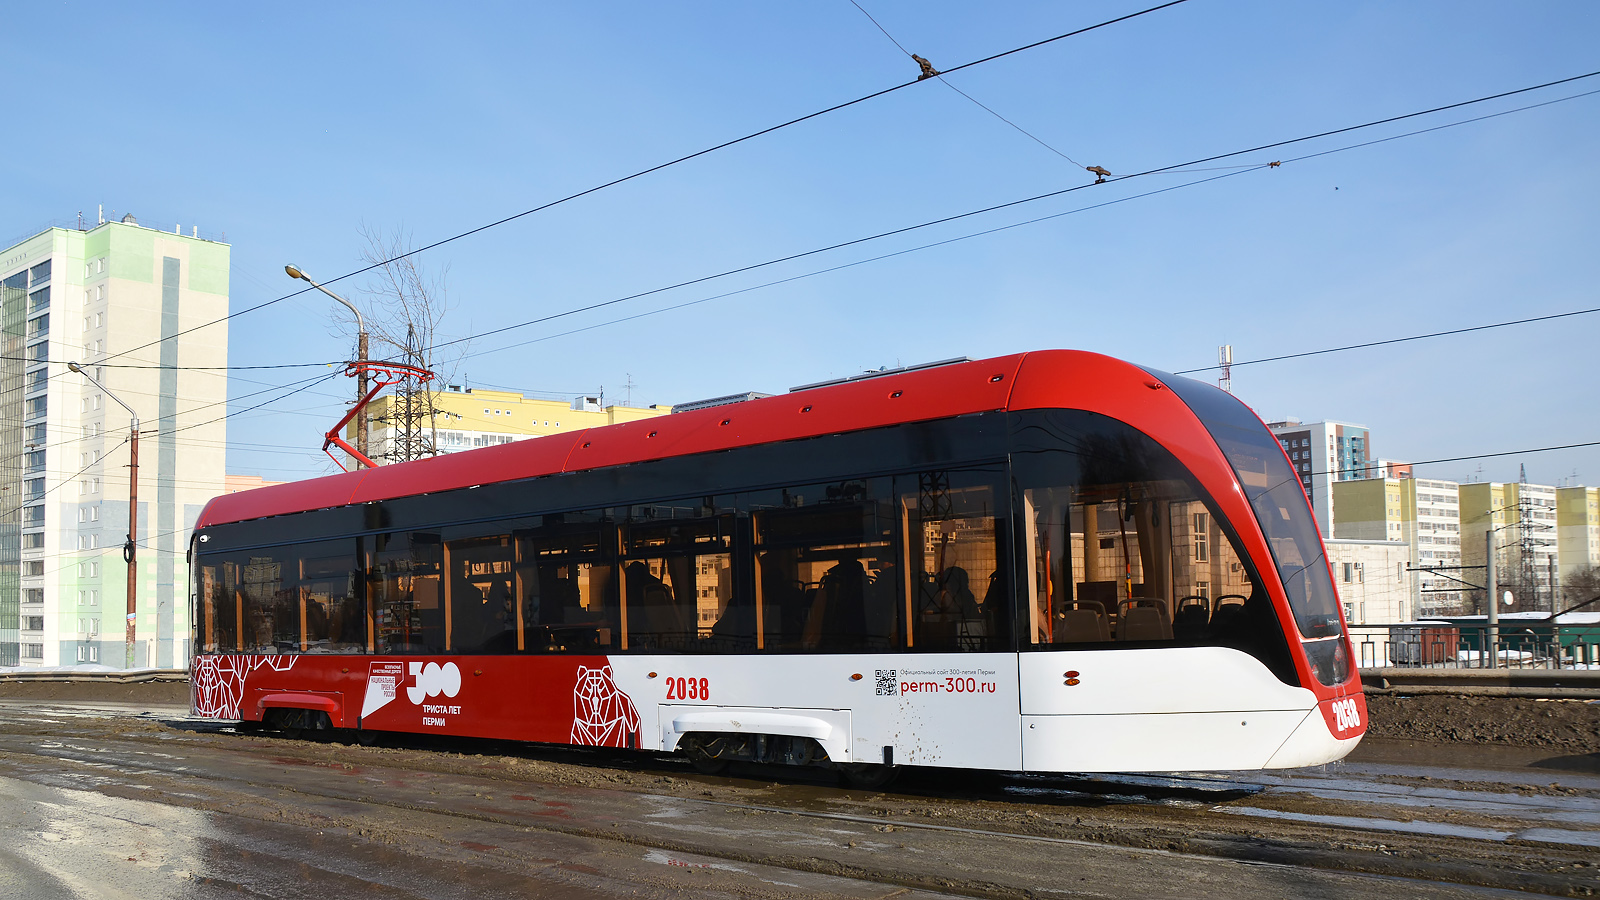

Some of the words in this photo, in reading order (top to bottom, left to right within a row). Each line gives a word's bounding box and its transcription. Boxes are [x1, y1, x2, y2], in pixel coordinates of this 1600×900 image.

[406, 662, 461, 704] 300
[665, 676, 709, 701] 2038
[900, 678, 996, 696] perm-300.ru
[422, 704, 448, 714] ТРИСТА
[448, 706, 461, 714] ЛЕТ
[1332, 698, 1361, 732] 2038
[422, 717, 446, 726] ПЕРМИ
